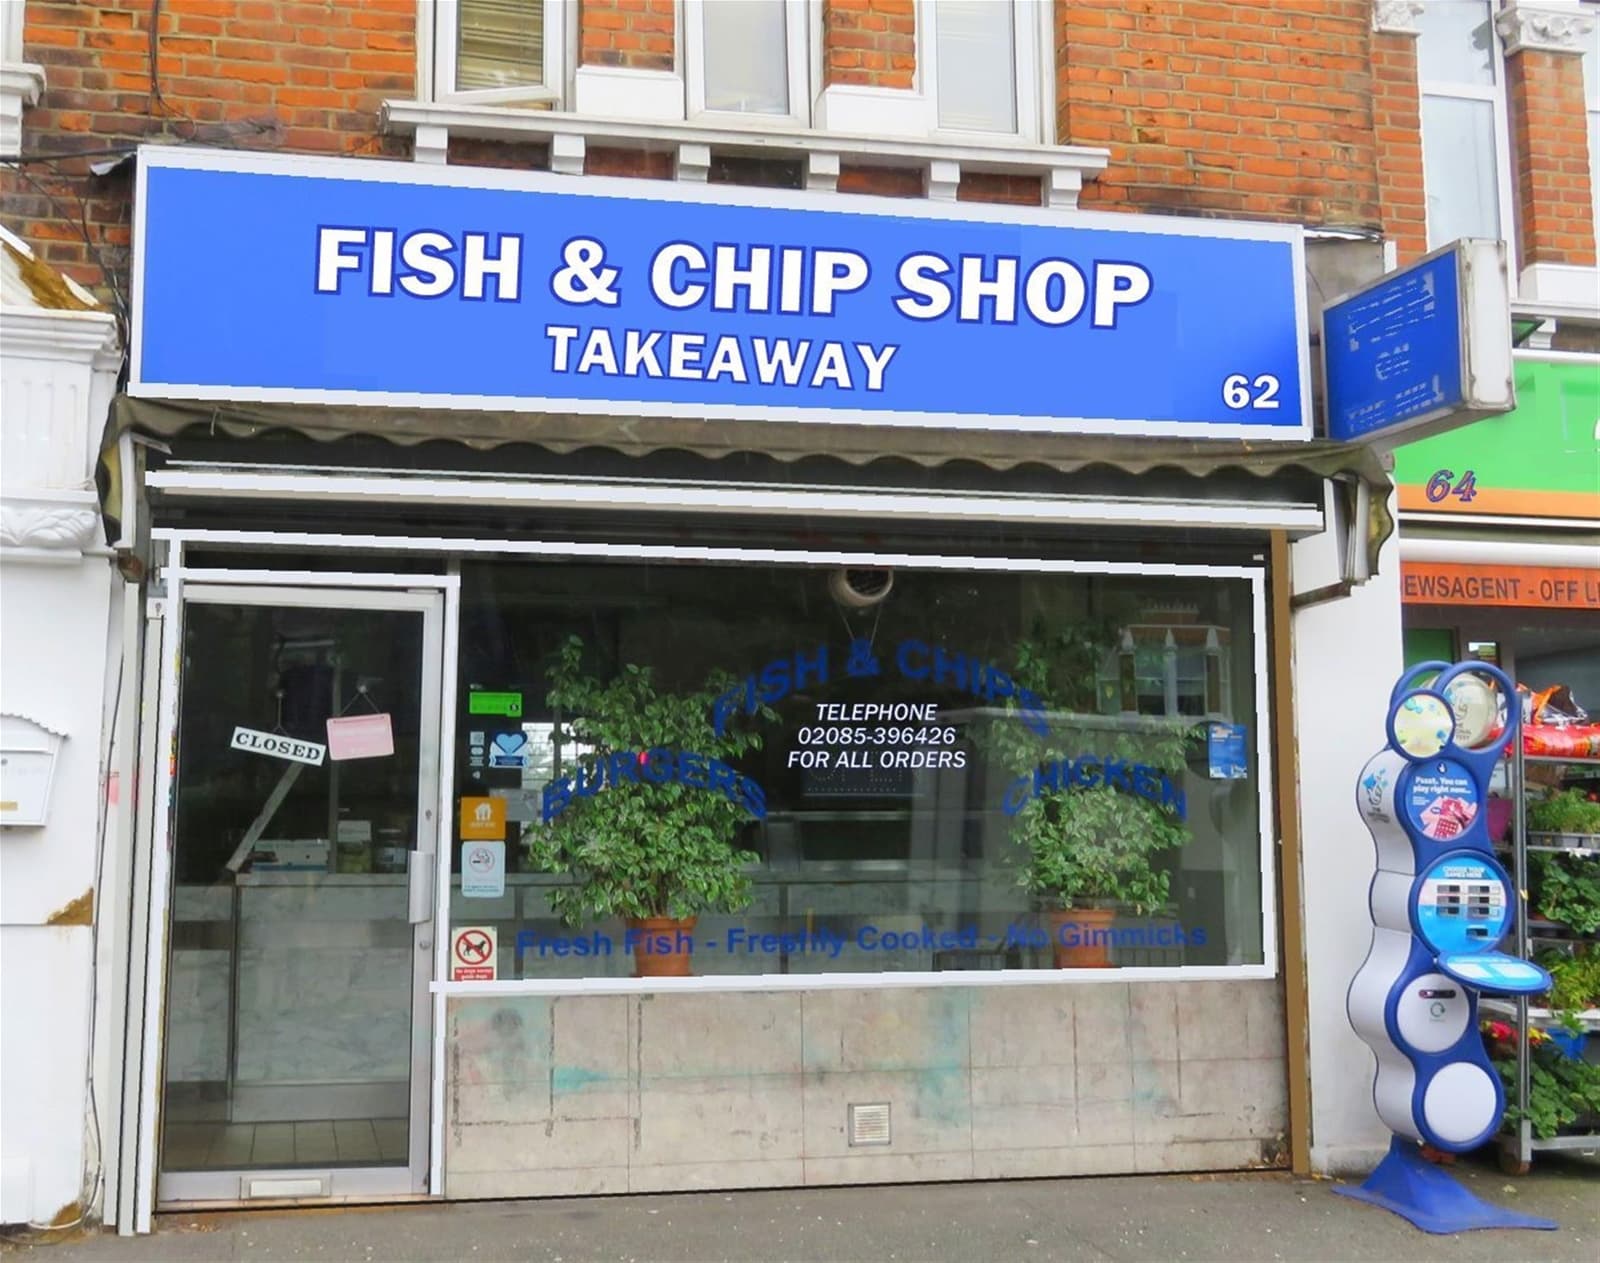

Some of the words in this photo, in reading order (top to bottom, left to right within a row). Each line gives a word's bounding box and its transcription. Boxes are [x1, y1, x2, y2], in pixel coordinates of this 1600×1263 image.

[314, 222, 524, 302] FISH
[549, 235, 621, 306] &
[649, 240, 871, 316] CHIP
[892, 251, 1153, 329] SHOP
[544, 324, 899, 393] TAKEAWAY
[1221, 374, 1281, 411] 62
[1426, 469, 1478, 503] 64
[1540, 579, 1578, 602] OFF
[713, 645, 829, 738] FISH
[846, 638, 880, 676] &
[896, 640, 1048, 737] CHIPS
[815, 703, 938, 721] TELEPHONE
[235, 731, 321, 761] CLOSED
[798, 726, 957, 745] 02085-396426
[787, 751, 830, 768] FOR
[835, 751, 873, 768] ALL
[879, 750, 967, 769] ORDERS
[542, 746, 768, 823] BURGERS
[1002, 752, 1188, 824] CHICKEN
[516, 930, 612, 957] Fresh
[624, 928, 693, 955] Fish
[727, 926, 847, 959] Freshly
[857, 923, 977, 951] Cooked
[1007, 923, 1048, 948] No
[1059, 921, 1209, 948] Gimmicks
